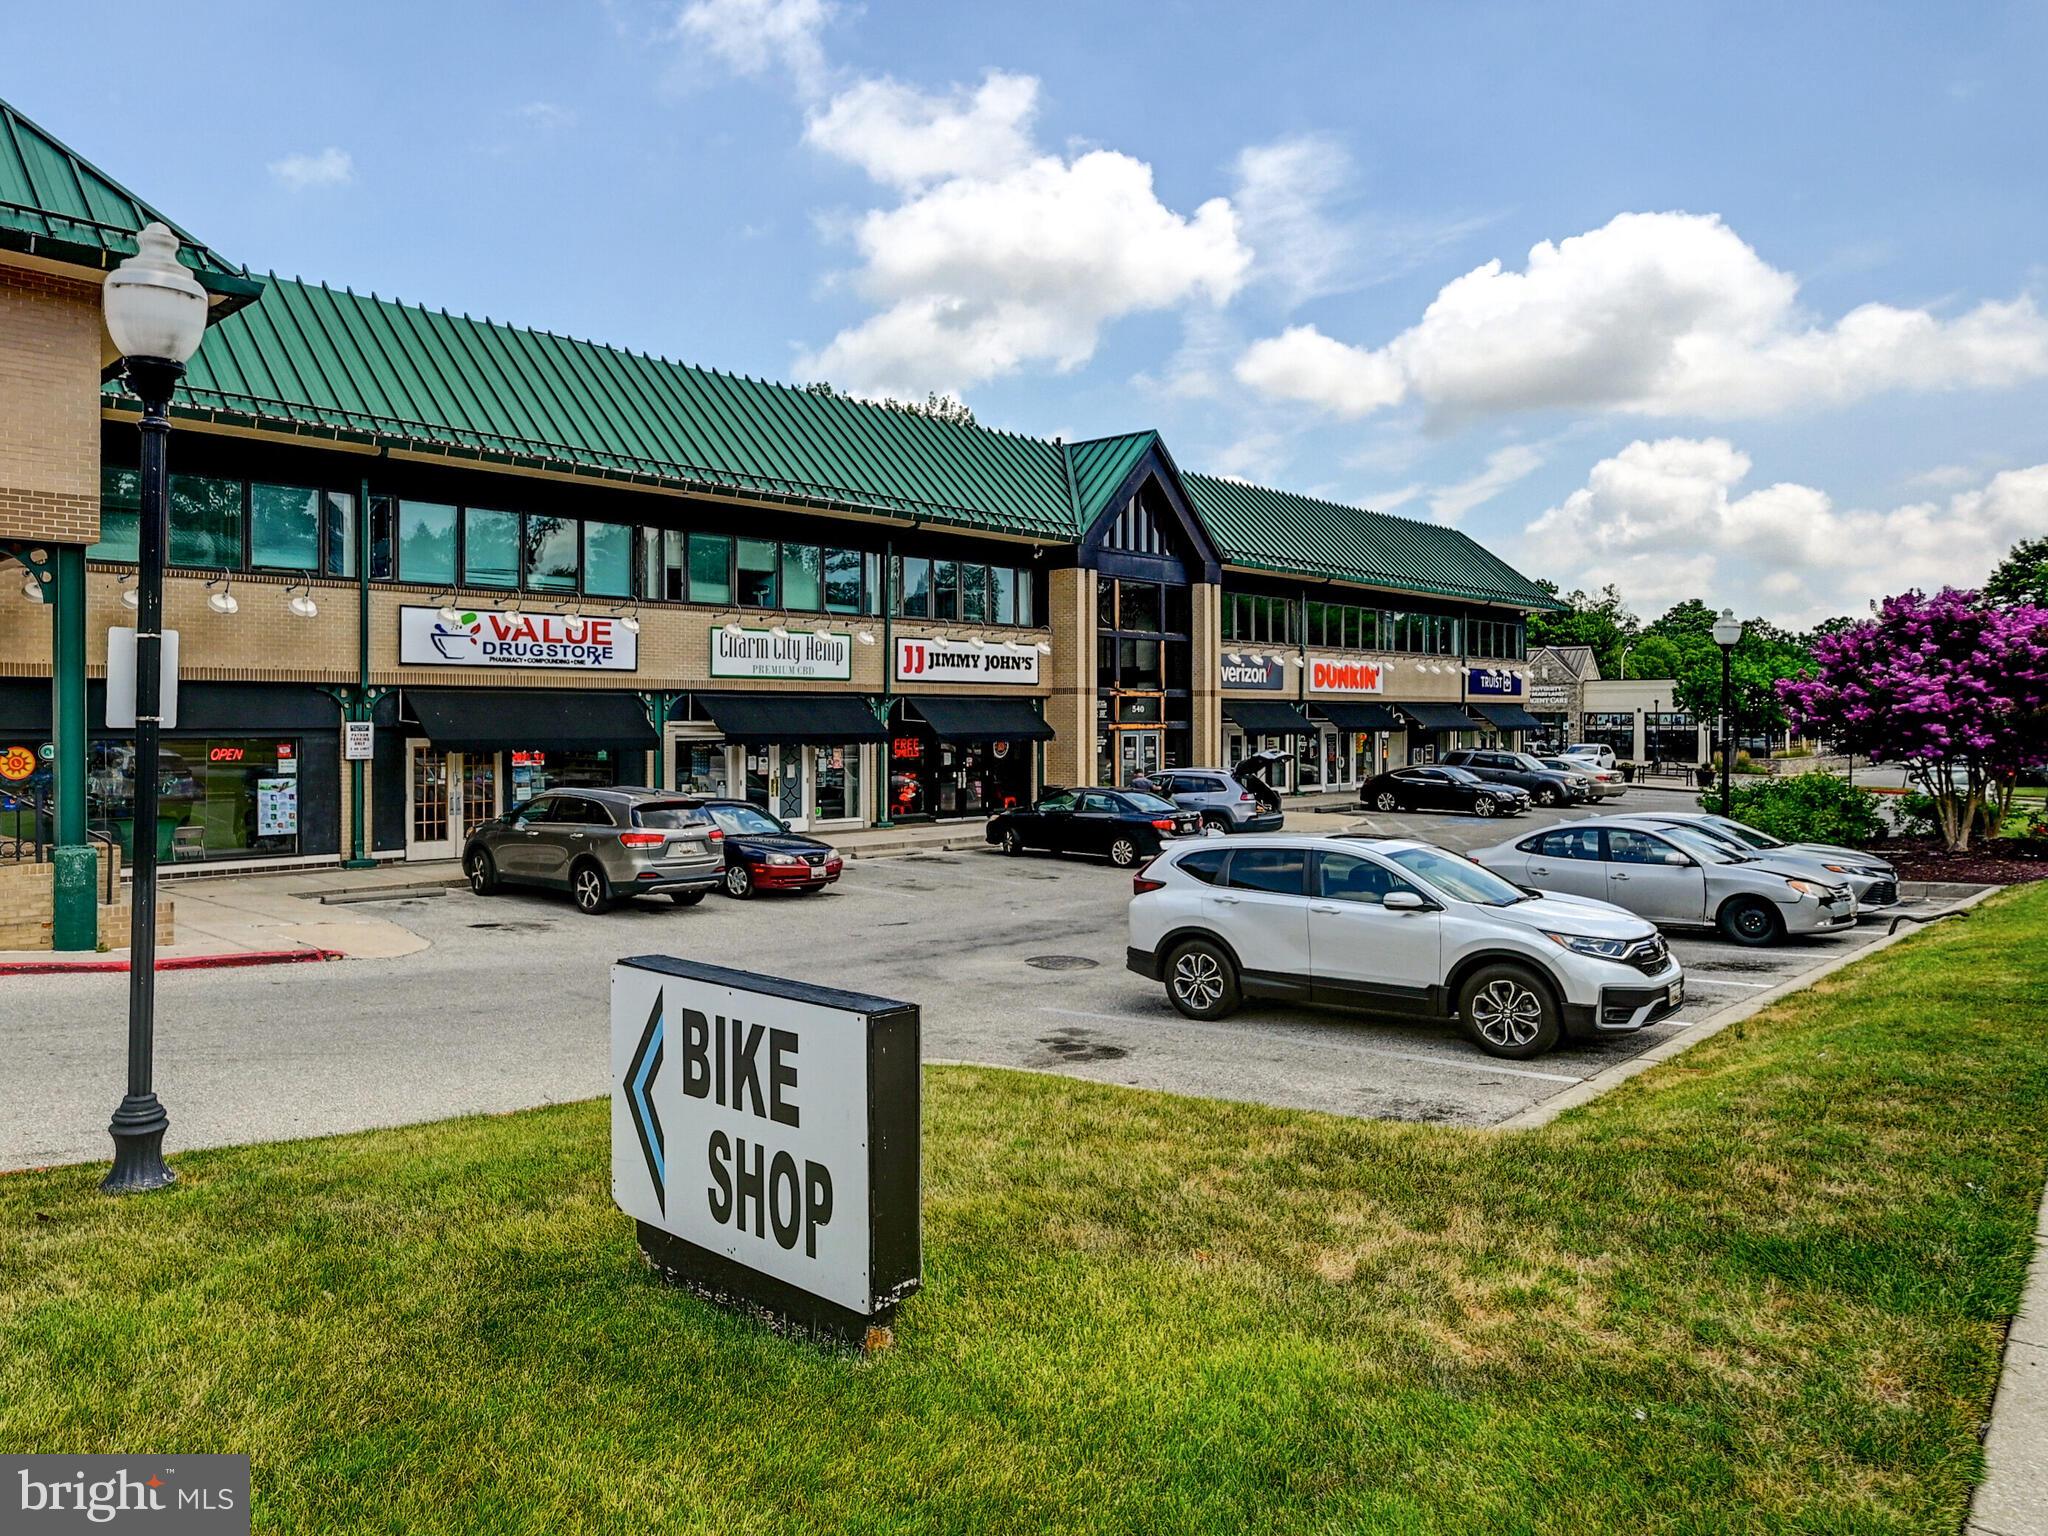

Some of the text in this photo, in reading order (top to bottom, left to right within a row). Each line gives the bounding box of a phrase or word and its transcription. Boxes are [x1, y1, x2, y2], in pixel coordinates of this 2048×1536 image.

[488, 615, 613, 646] VALUE
[719, 630, 769, 659] Charm
[805, 635, 844, 666] Hemp
[489, 656, 523, 664] PHARMACY
[903, 645, 925, 674] JJ
[928, 652, 1033, 672] JIMMY JOHN'S
[752, 664, 815, 676] PREMIUM CBD
[1220, 663, 1268, 684] verizon
[1314, 663, 1380, 690] DUNKIN'
[1480, 675, 1503, 689] TRUIST
[1131, 705, 1145, 713] 540
[894, 738, 920, 750] FREE
[210, 747, 244, 762] OPEN
[682, 1007, 800, 1129] BIKE
[707, 1129, 834, 1260] SHOP
